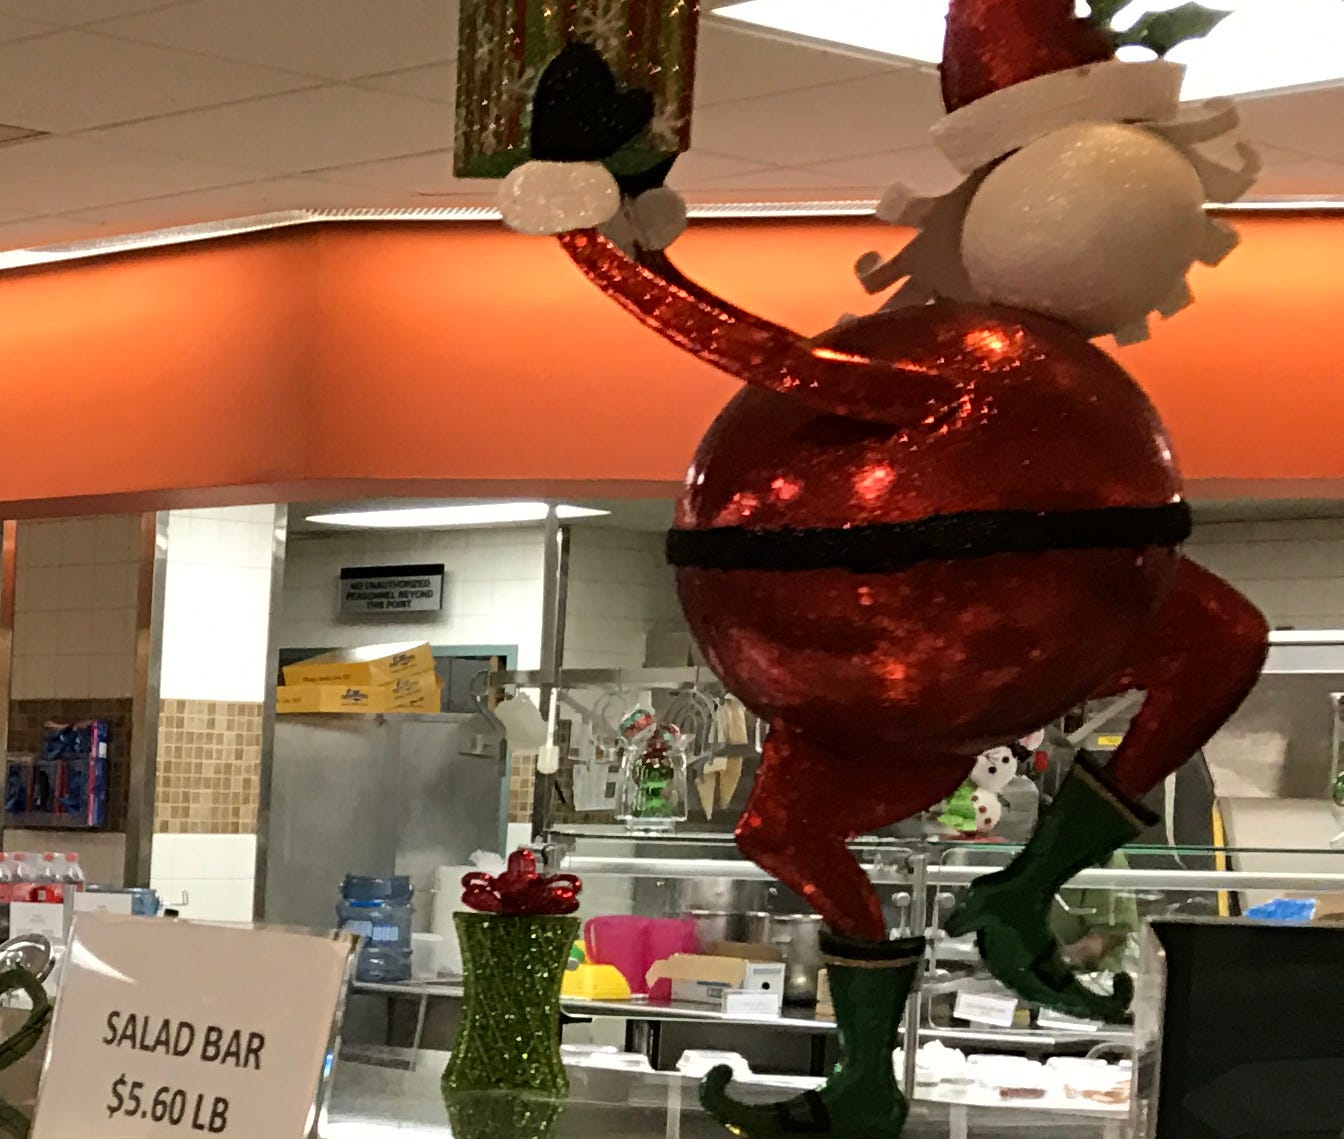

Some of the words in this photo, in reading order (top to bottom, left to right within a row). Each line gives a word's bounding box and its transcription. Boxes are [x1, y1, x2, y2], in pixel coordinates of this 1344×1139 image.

[398, 589, 434, 599] BEYOND
[102, 1010, 196, 1057] SALAD
[200, 1025, 266, 1070] BAR
[106, 1073, 187, 1125] $5.60
[191, 1093, 229, 1133] LB
